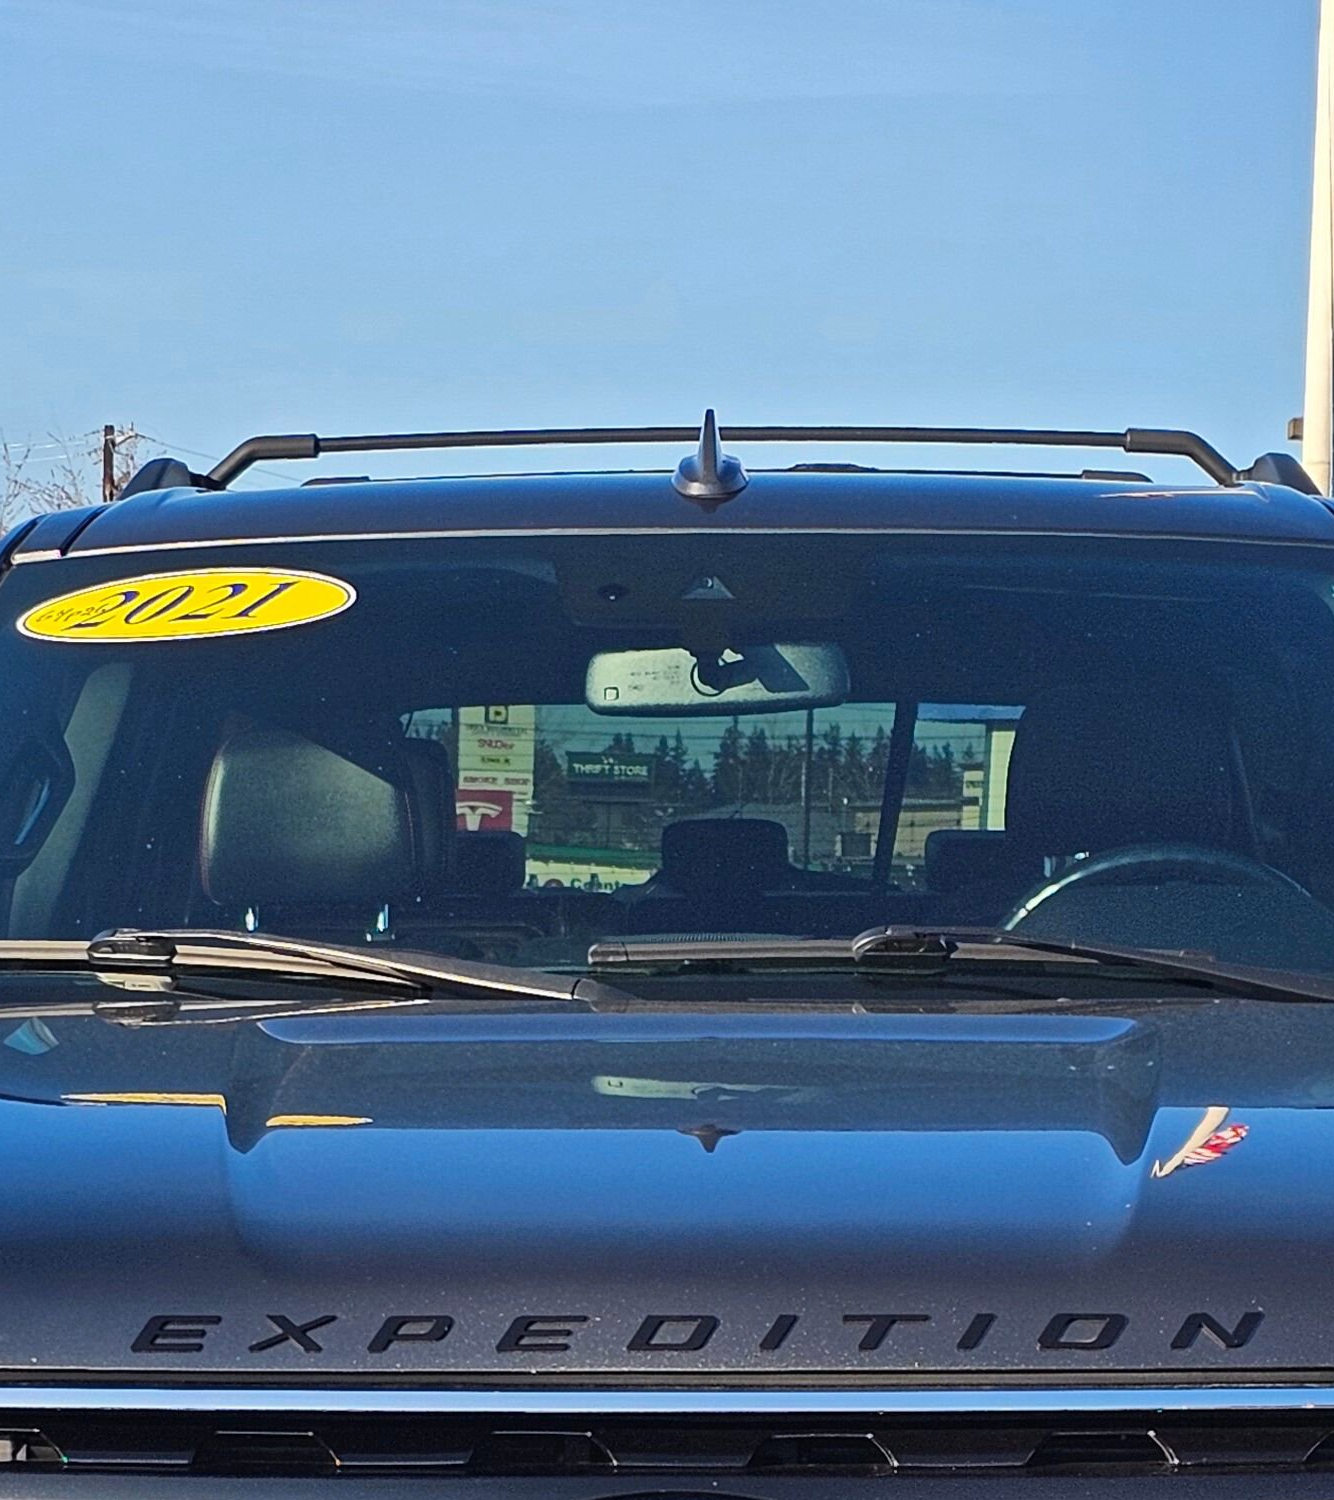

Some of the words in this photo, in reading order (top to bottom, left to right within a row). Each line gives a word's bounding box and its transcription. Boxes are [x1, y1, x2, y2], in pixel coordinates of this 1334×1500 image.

[61, 580, 301, 631] 2021
[572, 763, 611, 774] THRIFT
[613, 765, 648, 776] STORE
[130, 1312, 1265, 1355] EXPEDITION
